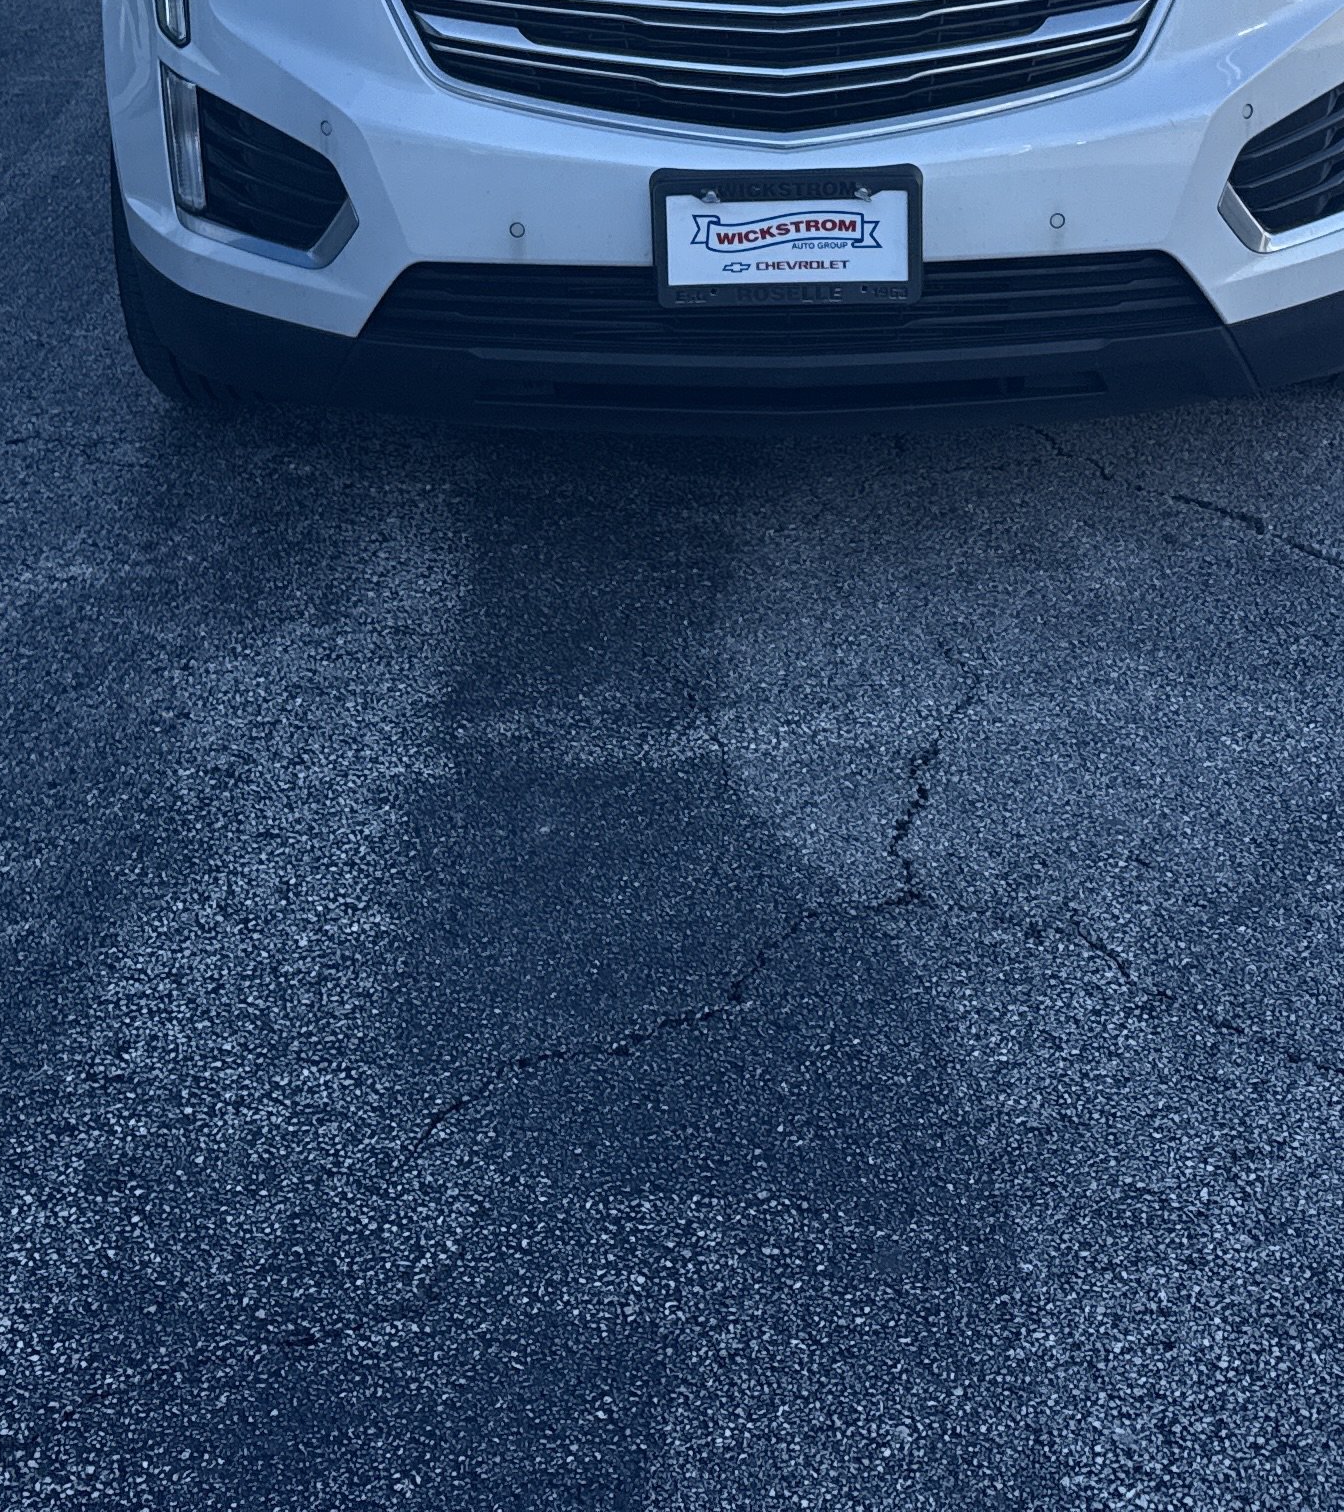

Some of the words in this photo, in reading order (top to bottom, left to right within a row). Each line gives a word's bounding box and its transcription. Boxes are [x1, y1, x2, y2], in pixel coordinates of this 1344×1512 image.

[718, 180, 856, 198] WICKSTROM
[716, 218, 857, 246] WICKSTROM
[791, 242, 816, 250] AUTO
[817, 241, 848, 250] GROUP
[755, 260, 850, 271] CHEVROLET
[737, 286, 843, 303] ROSELLE
